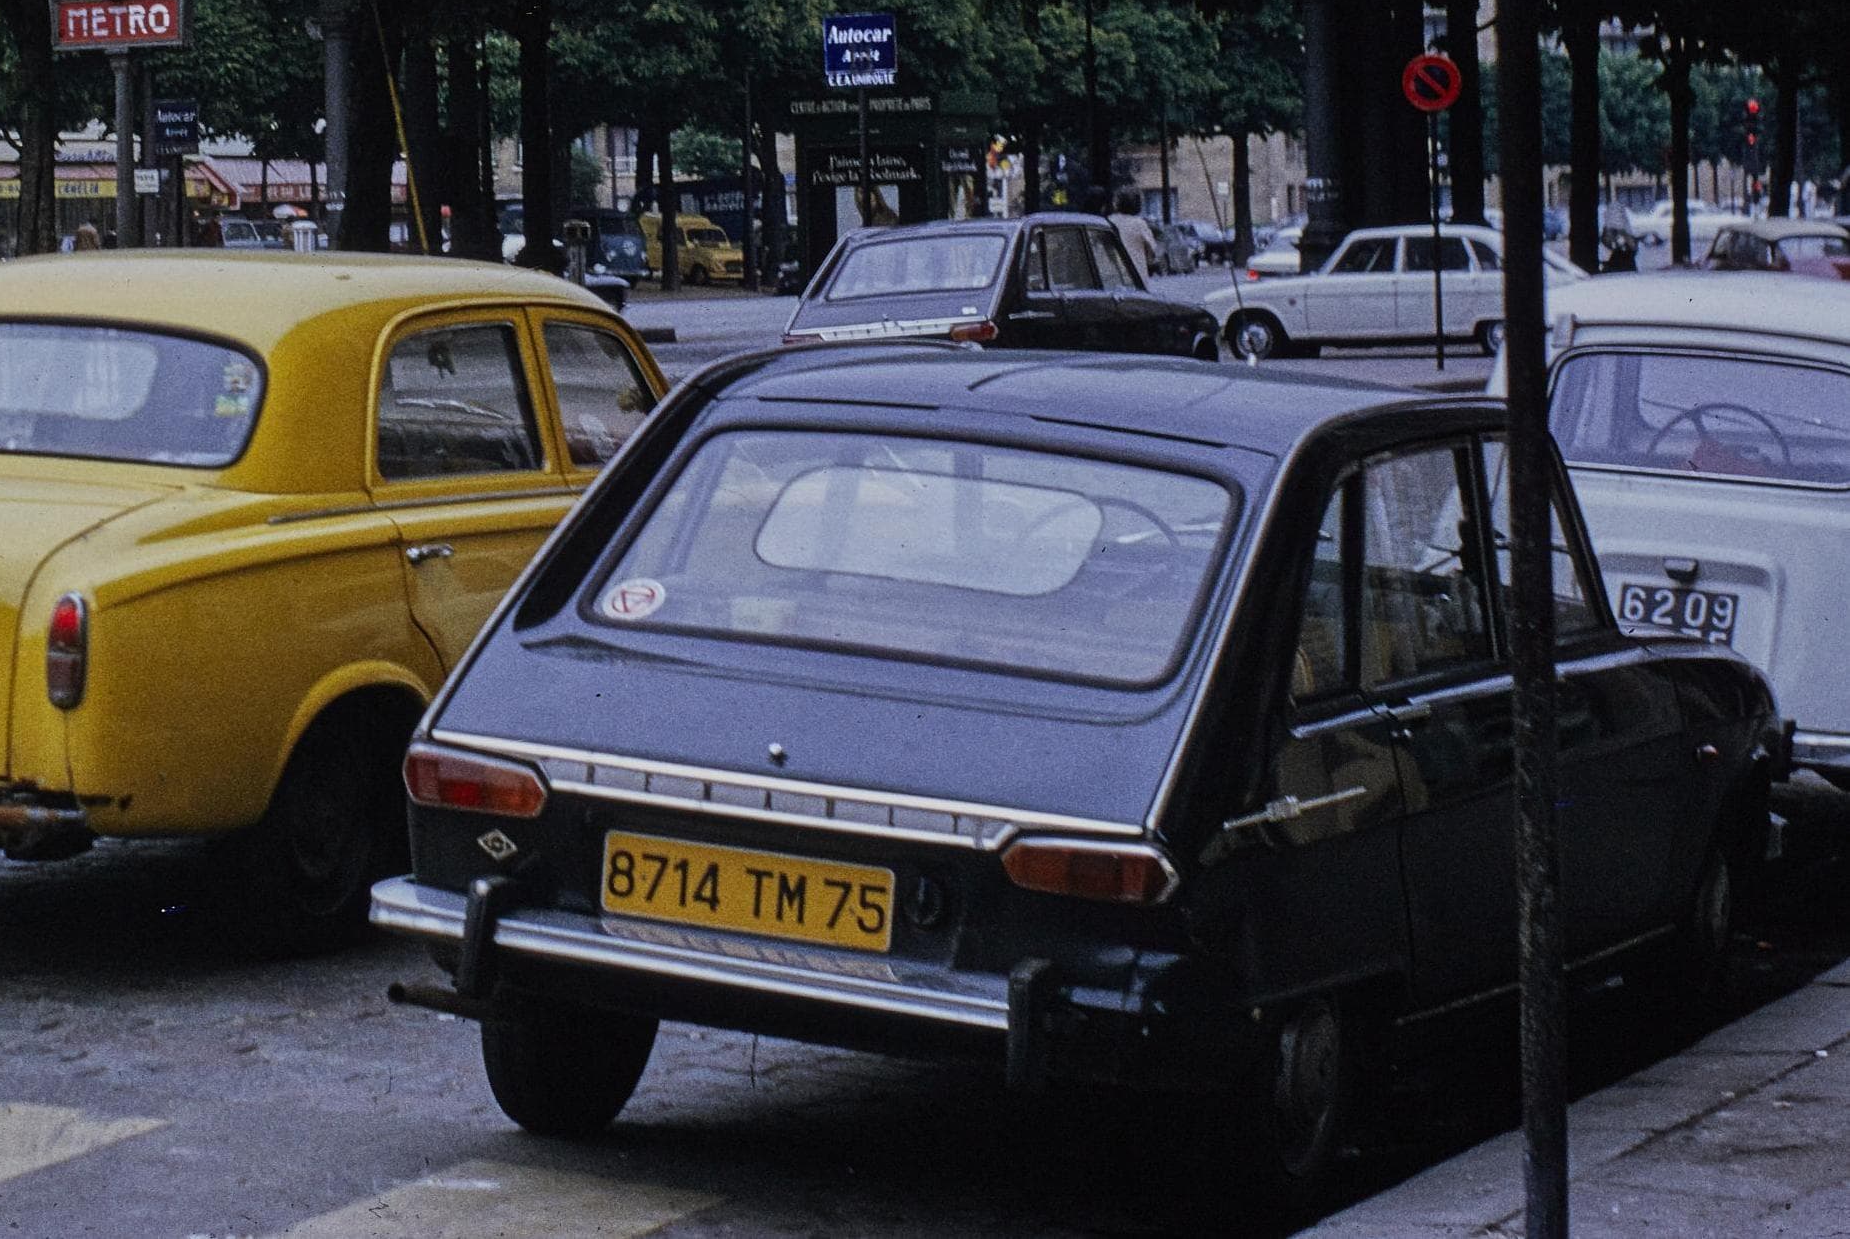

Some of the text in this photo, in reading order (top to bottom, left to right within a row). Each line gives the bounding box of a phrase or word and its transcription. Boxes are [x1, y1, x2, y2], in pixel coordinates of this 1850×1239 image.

[828, 25, 892, 44] Autocar
[1623, 586, 1734, 630] 6209
[607, 849, 889, 935] 8714 TM 75
